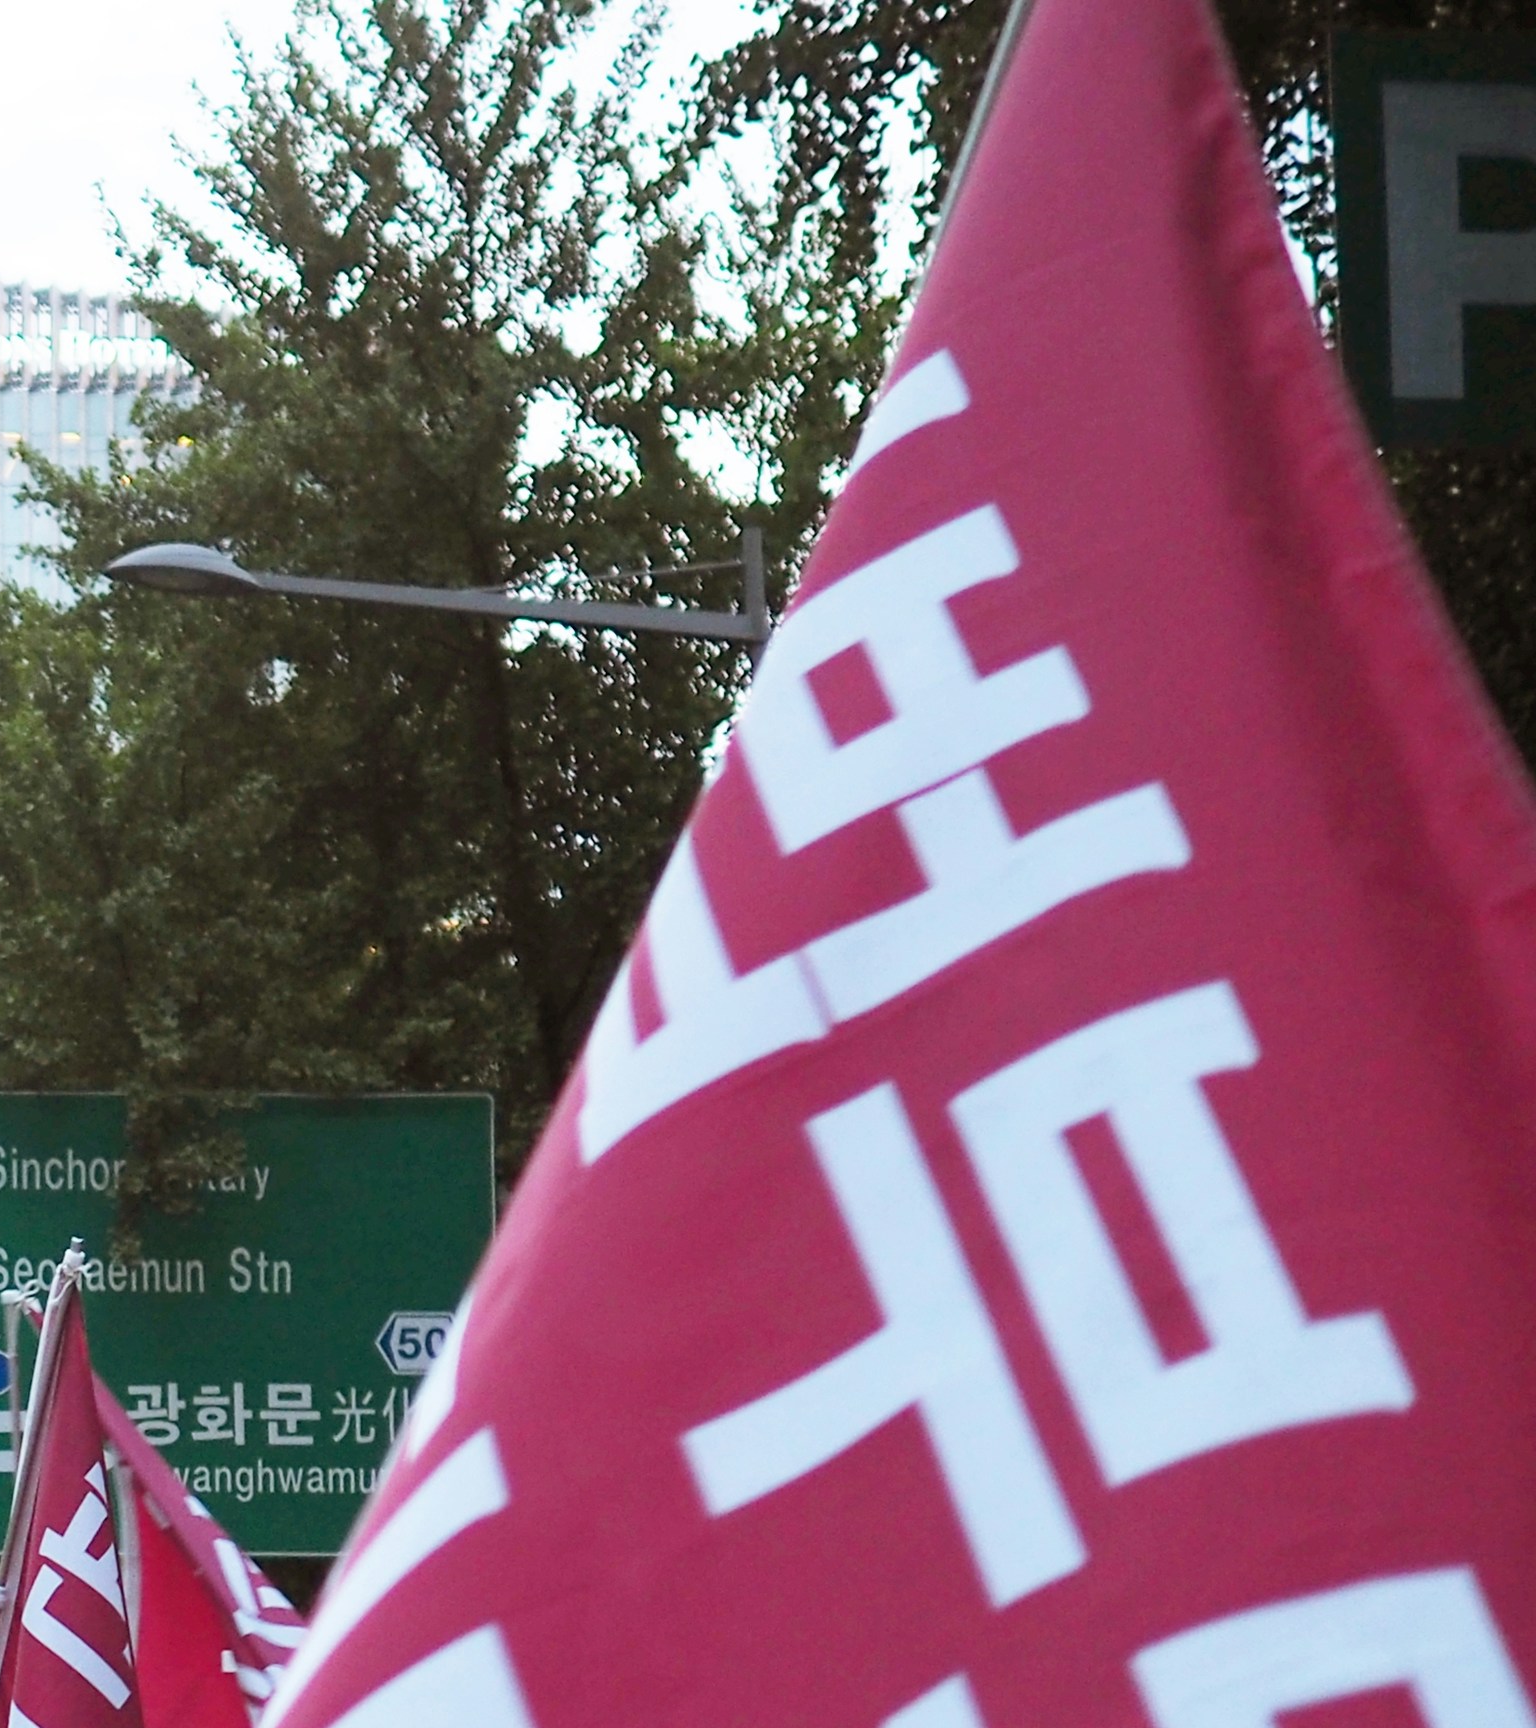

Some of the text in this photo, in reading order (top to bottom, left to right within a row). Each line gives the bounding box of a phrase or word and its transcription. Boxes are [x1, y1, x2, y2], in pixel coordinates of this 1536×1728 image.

[229, 1247, 292, 1293] Stn
[126, 1381, 321, 1446] 광화문
[173, 1458, 380, 1502] wanghwamu
